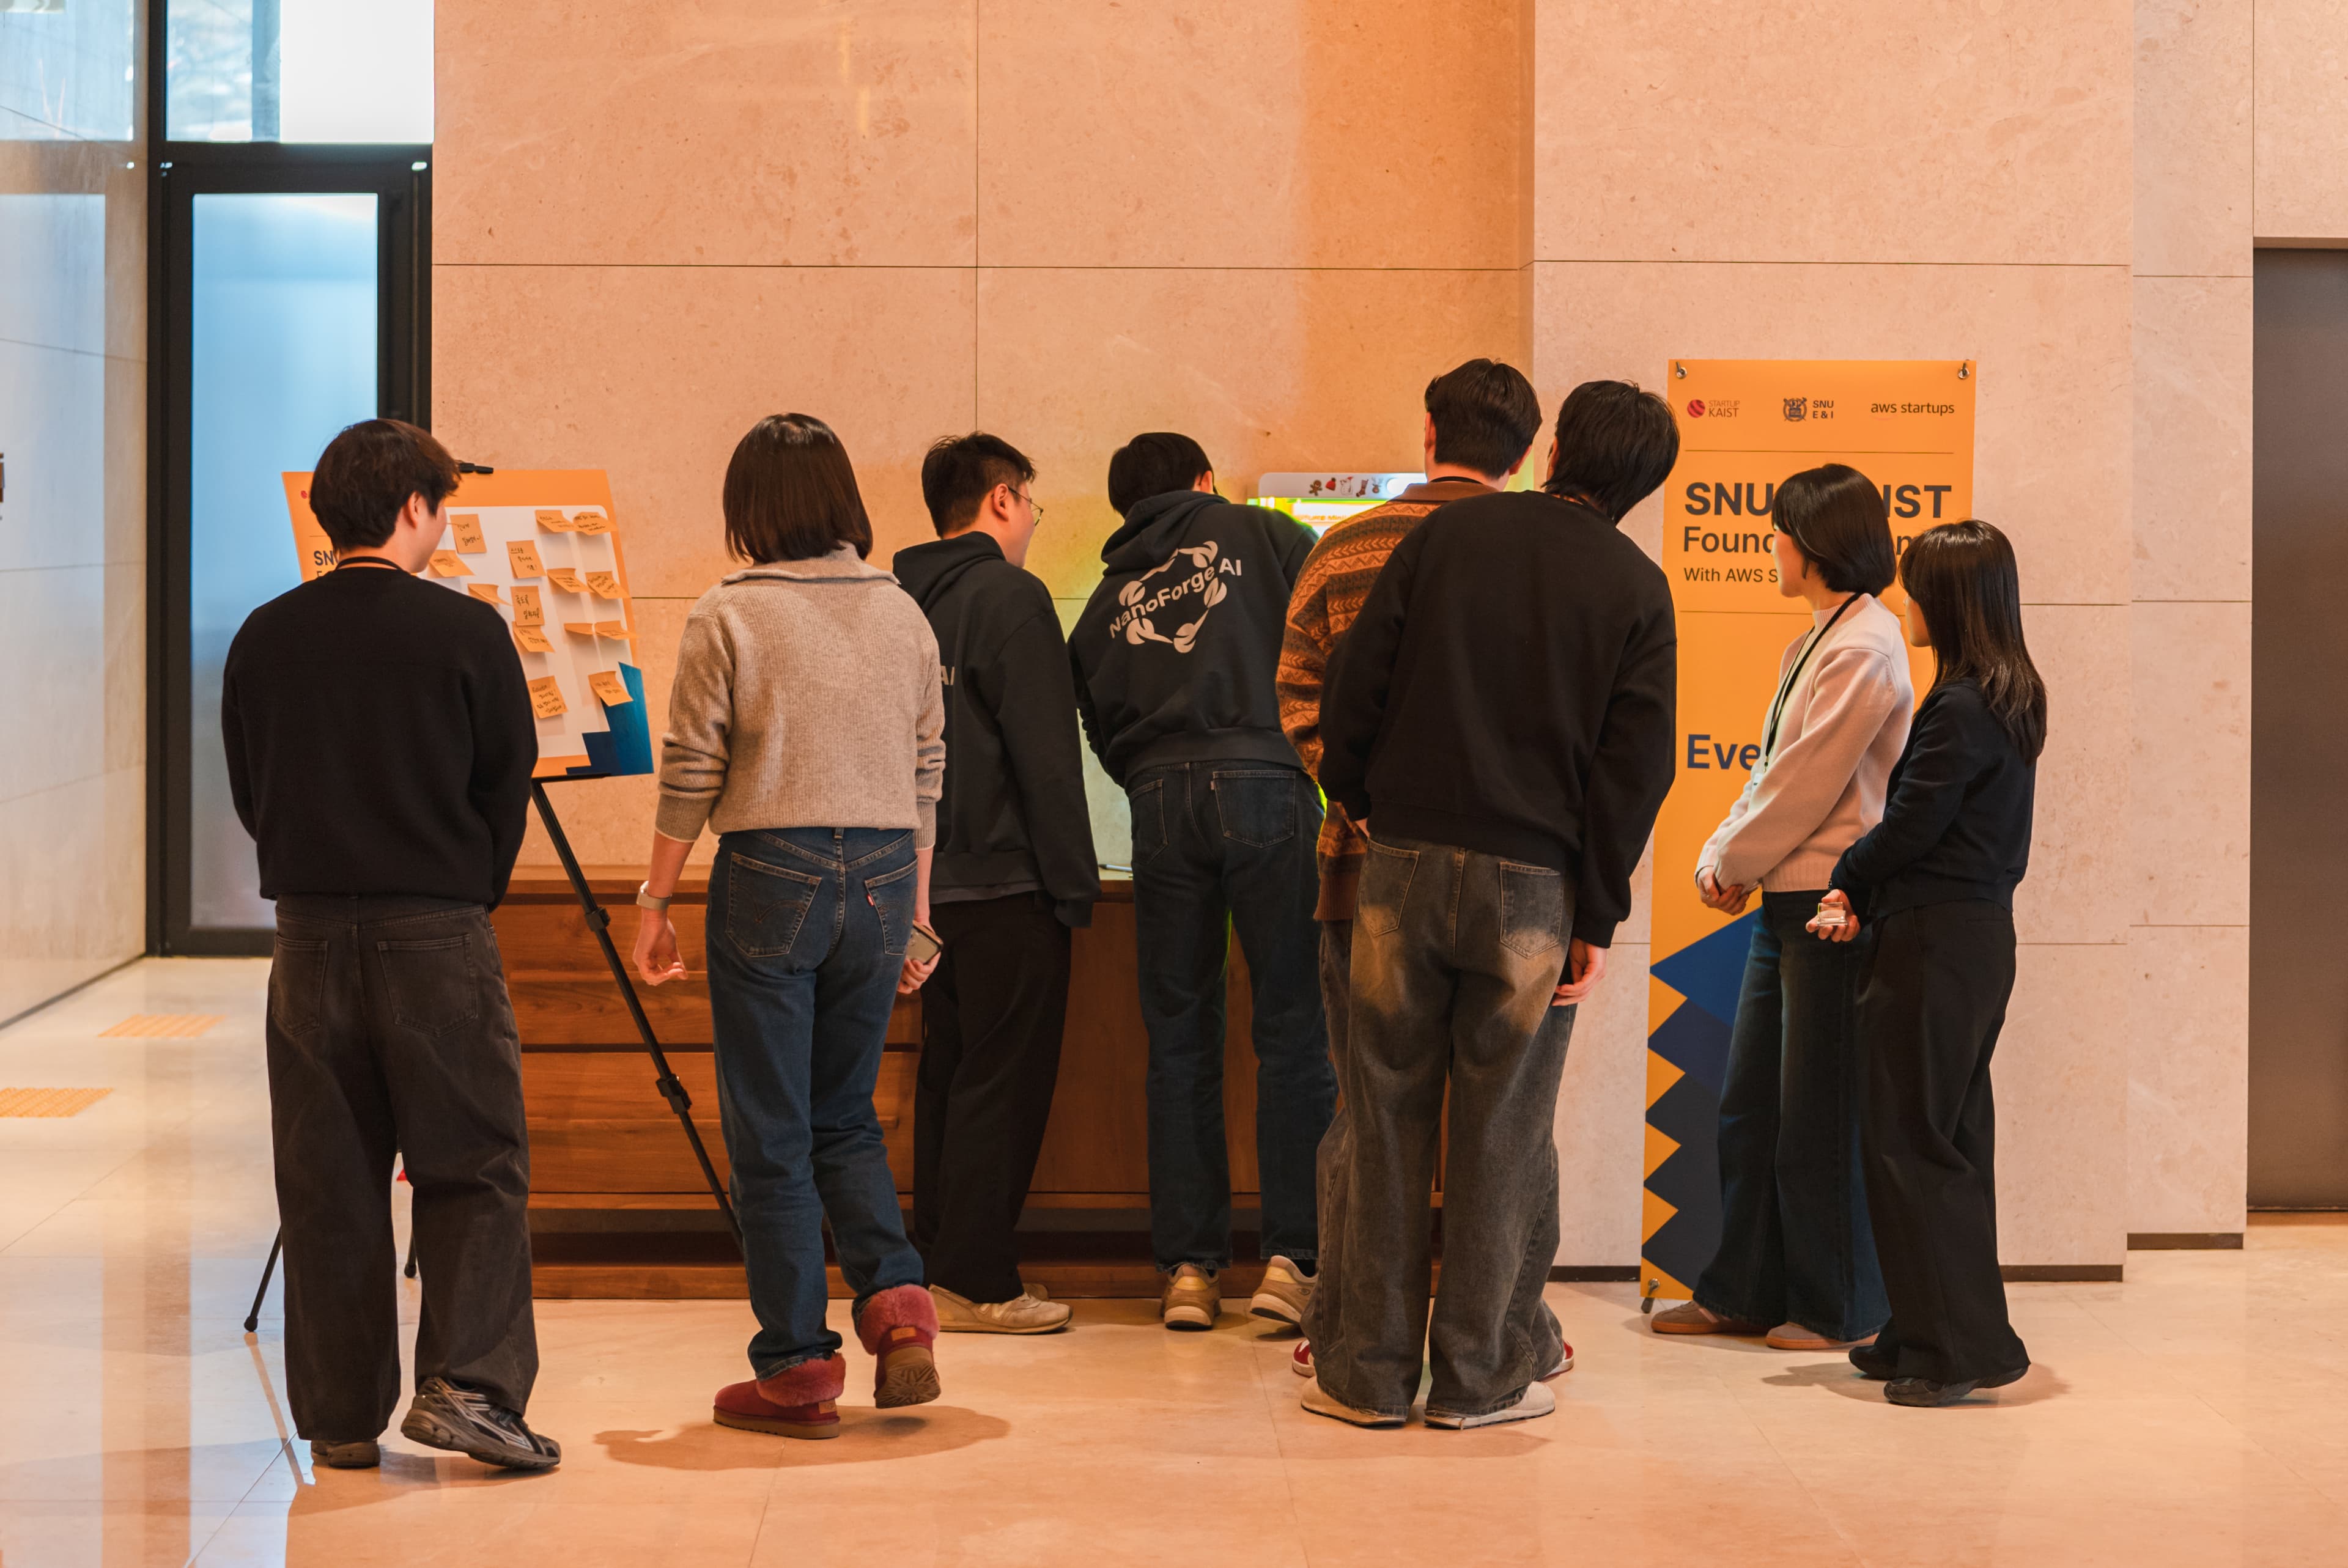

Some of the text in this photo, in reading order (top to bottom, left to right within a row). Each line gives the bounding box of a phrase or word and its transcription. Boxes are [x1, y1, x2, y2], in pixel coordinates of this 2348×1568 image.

[1709, 408, 1739, 418] KAIST
[1870, 402, 1955, 416] aws startups
[1685, 482, 1952, 518] SNU IST
[1684, 567, 1720, 581] With
[1725, 568, 1763, 582] AWS
[1109, 558, 1242, 639] NanoForge AI
[1688, 734, 1761, 771] Eve
